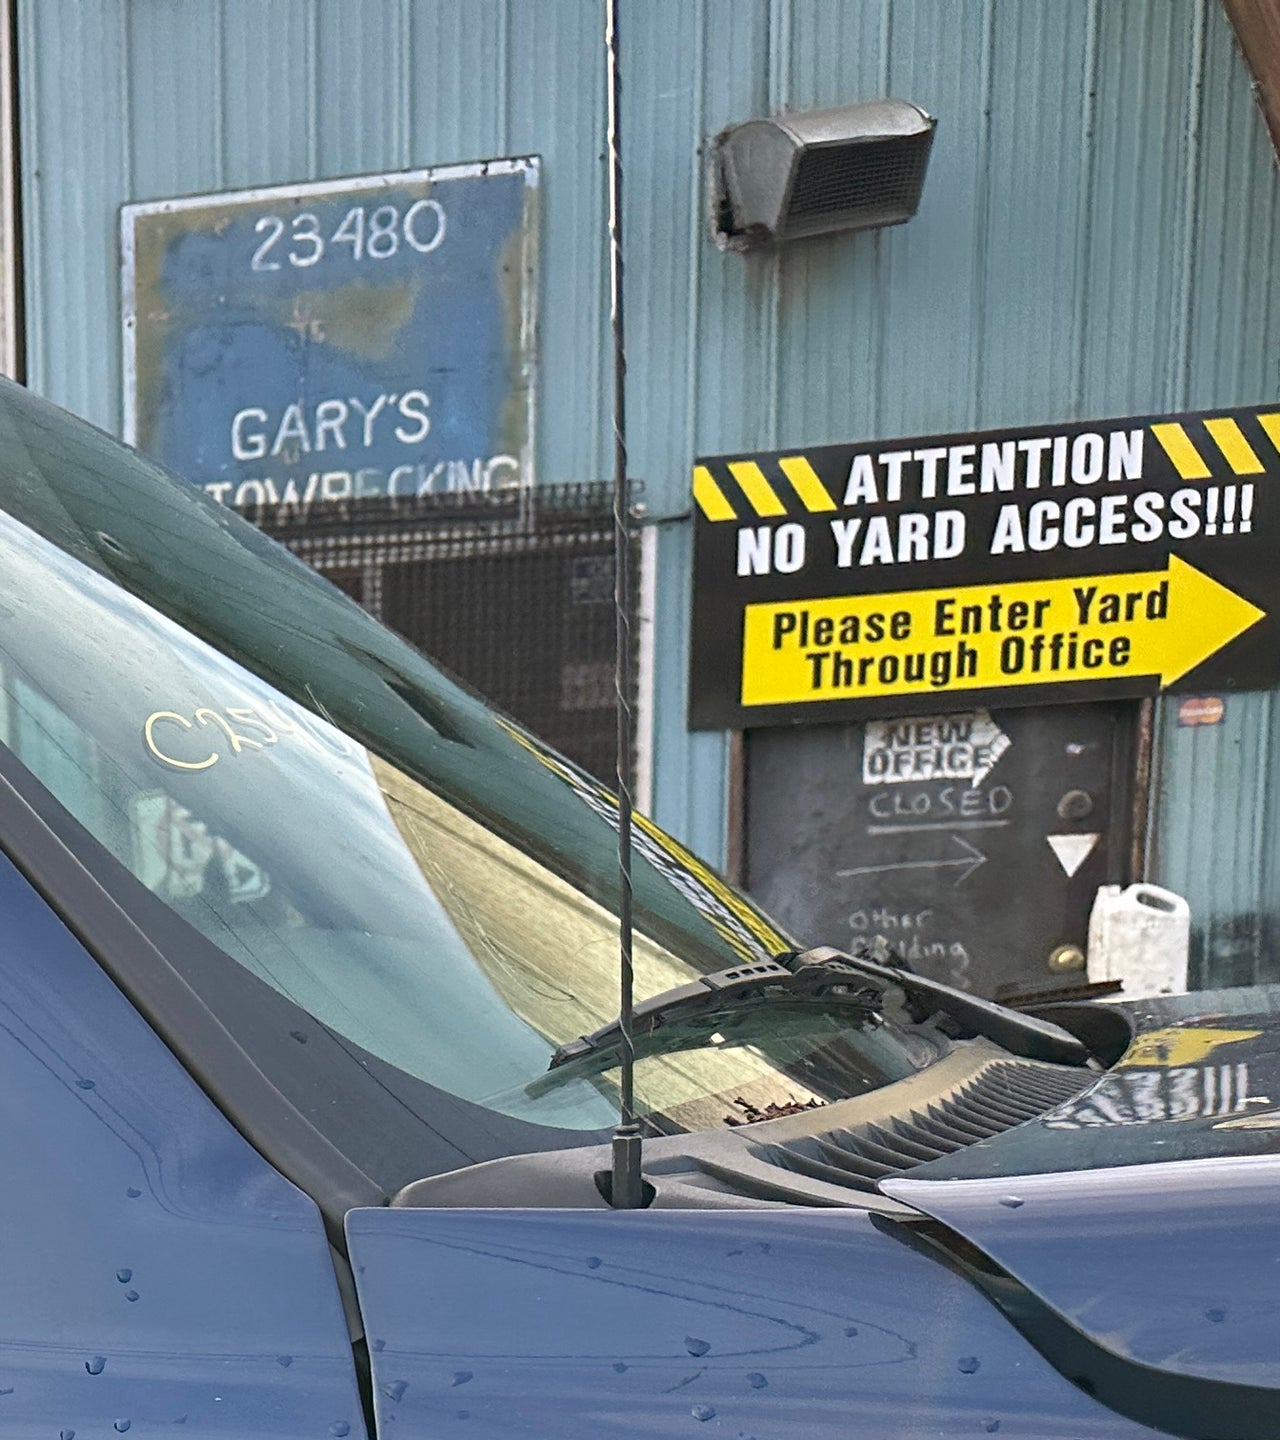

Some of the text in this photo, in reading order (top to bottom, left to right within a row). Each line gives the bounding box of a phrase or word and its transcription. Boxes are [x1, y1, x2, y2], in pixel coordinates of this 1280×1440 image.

[250, 199, 447, 272] 23480
[231, 389, 431, 461] GARY'S
[843, 429, 1144, 505] ATTENTION
[736, 484, 1255, 577] NO YARD ACCESS!!!
[772, 581, 1169, 650] Please Enter Yard
[805, 633, 1131, 689] Through Office
[889, 721, 972, 747] NEW
[868, 786, 1013, 818] CLOSED
